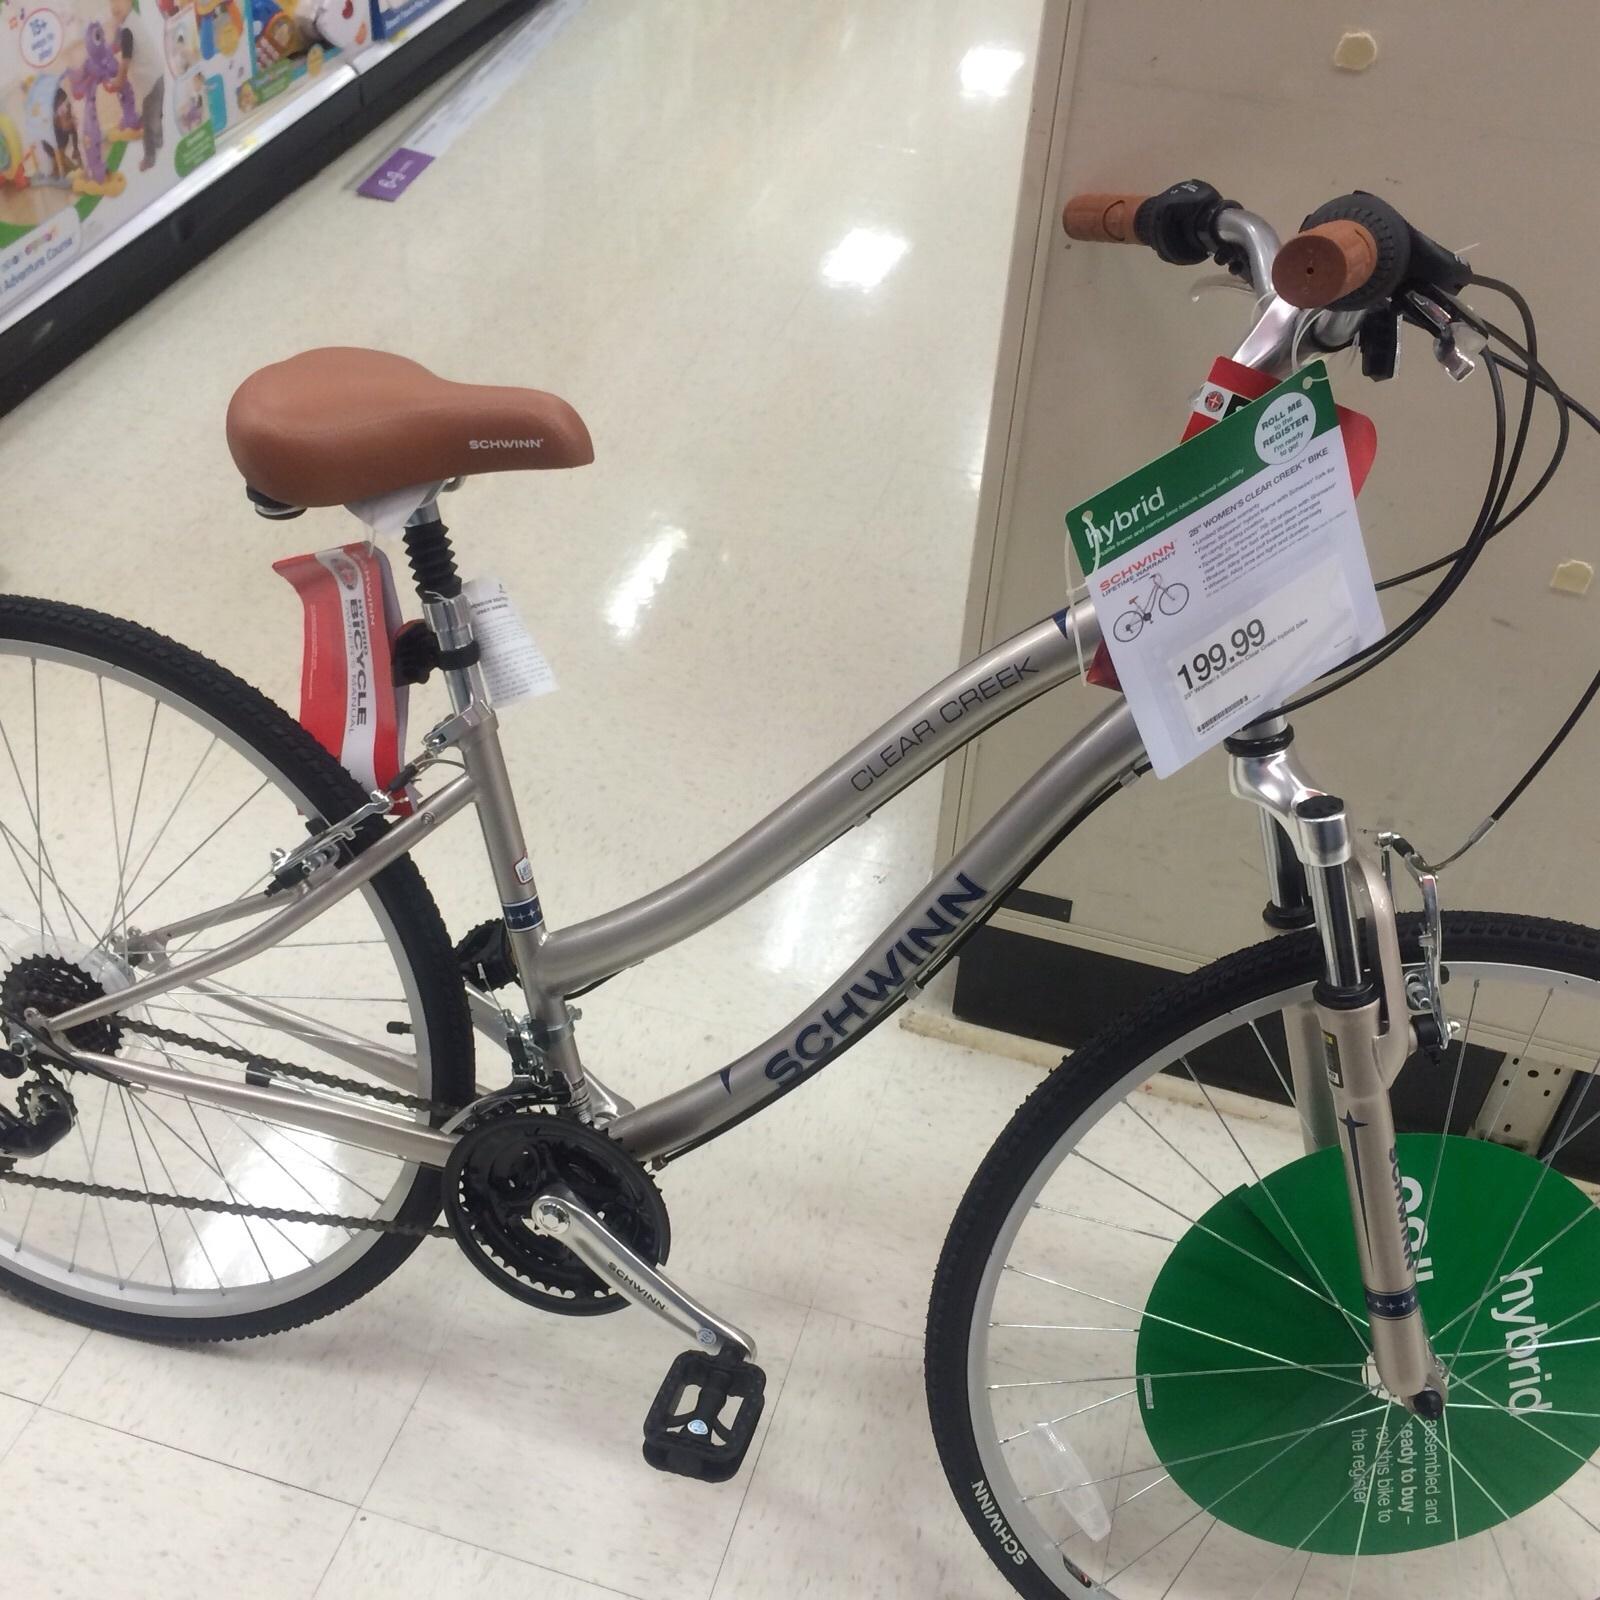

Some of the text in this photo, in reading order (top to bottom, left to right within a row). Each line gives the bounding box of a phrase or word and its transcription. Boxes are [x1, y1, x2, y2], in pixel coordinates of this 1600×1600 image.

[1261, 399, 1302, 430] ROLL ME
[1262, 414, 1308, 448] REGISTER
[1273, 416, 1293, 431] to the
[468, 439, 541, 450] SCHWINN
[1273, 431, 1303, 452] I'm ready
[1287, 441, 1298, 453] go!
[1202, 499, 1243, 528] WOMEN'S
[1244, 480, 1272, 502] CLEAR
[1307, 447, 1328, 463] BIKE
[1085, 486, 1165, 549] hybrid
[1100, 541, 1174, 594] SCHWINN
[1102, 575, 1133, 597] LIFETIME
[1135, 548, 1175, 576] WARRANTY
[1178, 619, 1264, 688] 199.99
[1244, 649, 1259, 660] Clear
[1260, 638, 1276, 650] Creek
[1277, 625, 1295, 640] hybrid
[1295, 618, 1307, 628] bike
[350, 598, 368, 726] BICYCLE
[850, 655, 1040, 792] CLEAR CREEK
[764, 872, 988, 1088] SCHWINN
[608, 1262, 666, 1310] SCHWINN
[1490, 1266, 1553, 1417] hybrid
[1348, 1428, 1369, 1504] the register
[1377, 1450, 1394, 1476] this
[1397, 1423, 1418, 1465] ready
[1377, 1478, 1394, 1507] bike
[1401, 1467, 1417, 1484] to
[1424, 1419, 1442, 1525] assembled and
[1377, 1509, 1394, 1523] to
[1398, 1486, 1418, 1513] buy
[971, 1480, 1028, 1565] SCHWINN
